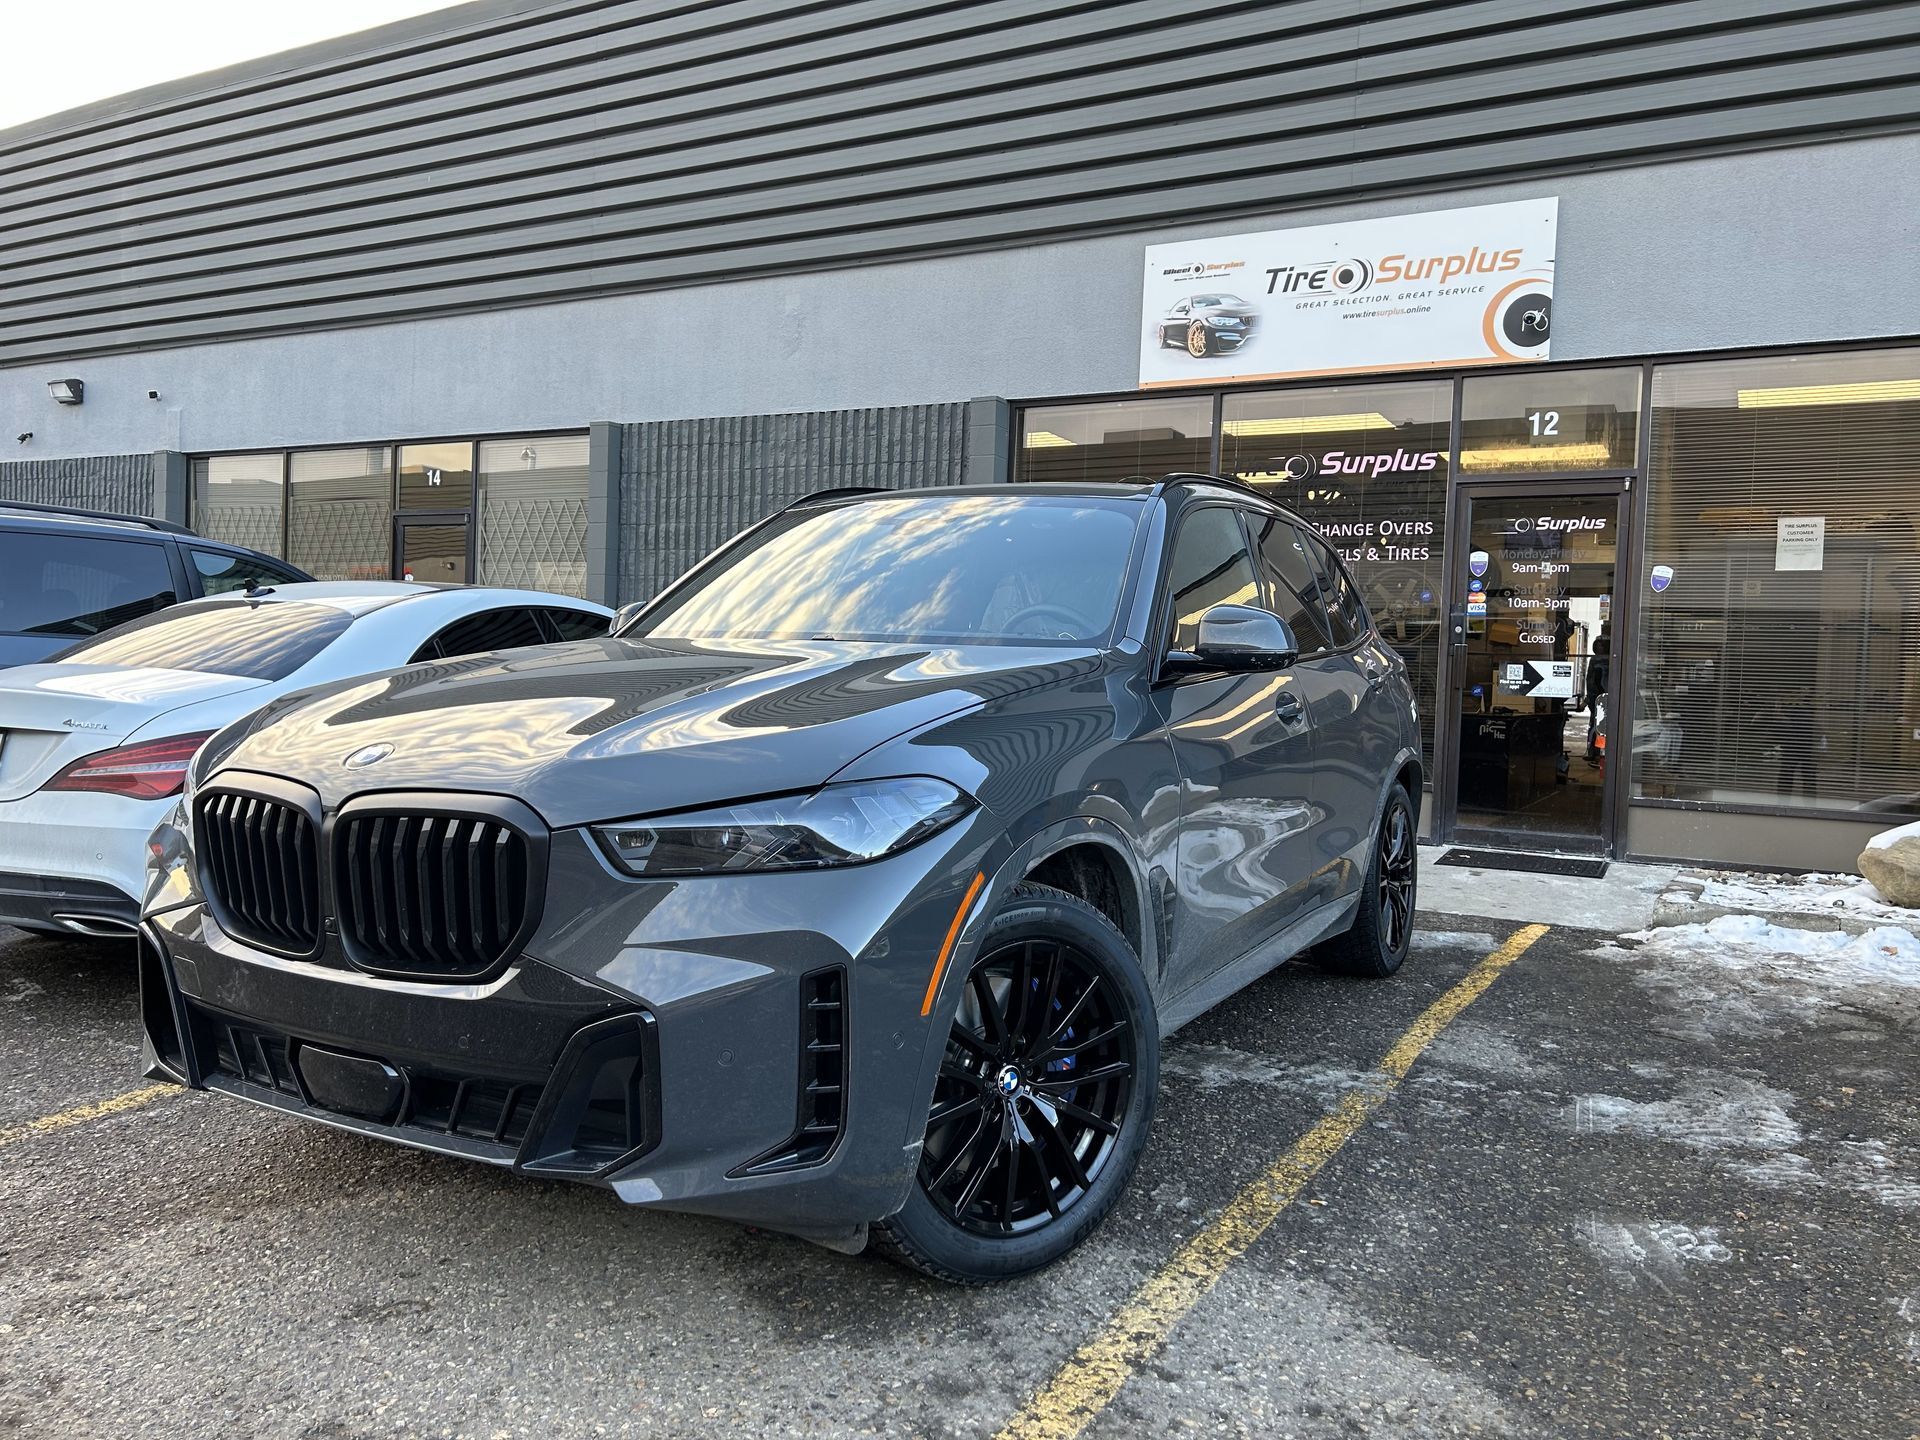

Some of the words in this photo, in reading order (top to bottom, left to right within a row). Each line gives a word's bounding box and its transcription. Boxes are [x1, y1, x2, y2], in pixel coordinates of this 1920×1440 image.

[1265, 266, 1329, 295] Tire
[1375, 246, 1524, 285] Surplus
[1295, 300, 1329, 310] GREAT
[1398, 290, 1433, 300] GREAT
[1437, 285, 1486, 297] SERVICE
[1342, 304, 1432, 321] www.tiresurplus.online
[1528, 411, 1560, 436] 12
[1319, 448, 1438, 478] Surplus
[426, 469, 441, 486] 14
[1535, 515, 1607, 533] Surplus
[1366, 547, 1380, 561] &
[1511, 562, 1570, 576] 9am-pm
[1507, 597, 1571, 611] 10am-3pm
[1515, 619, 1561, 633] Sunay
